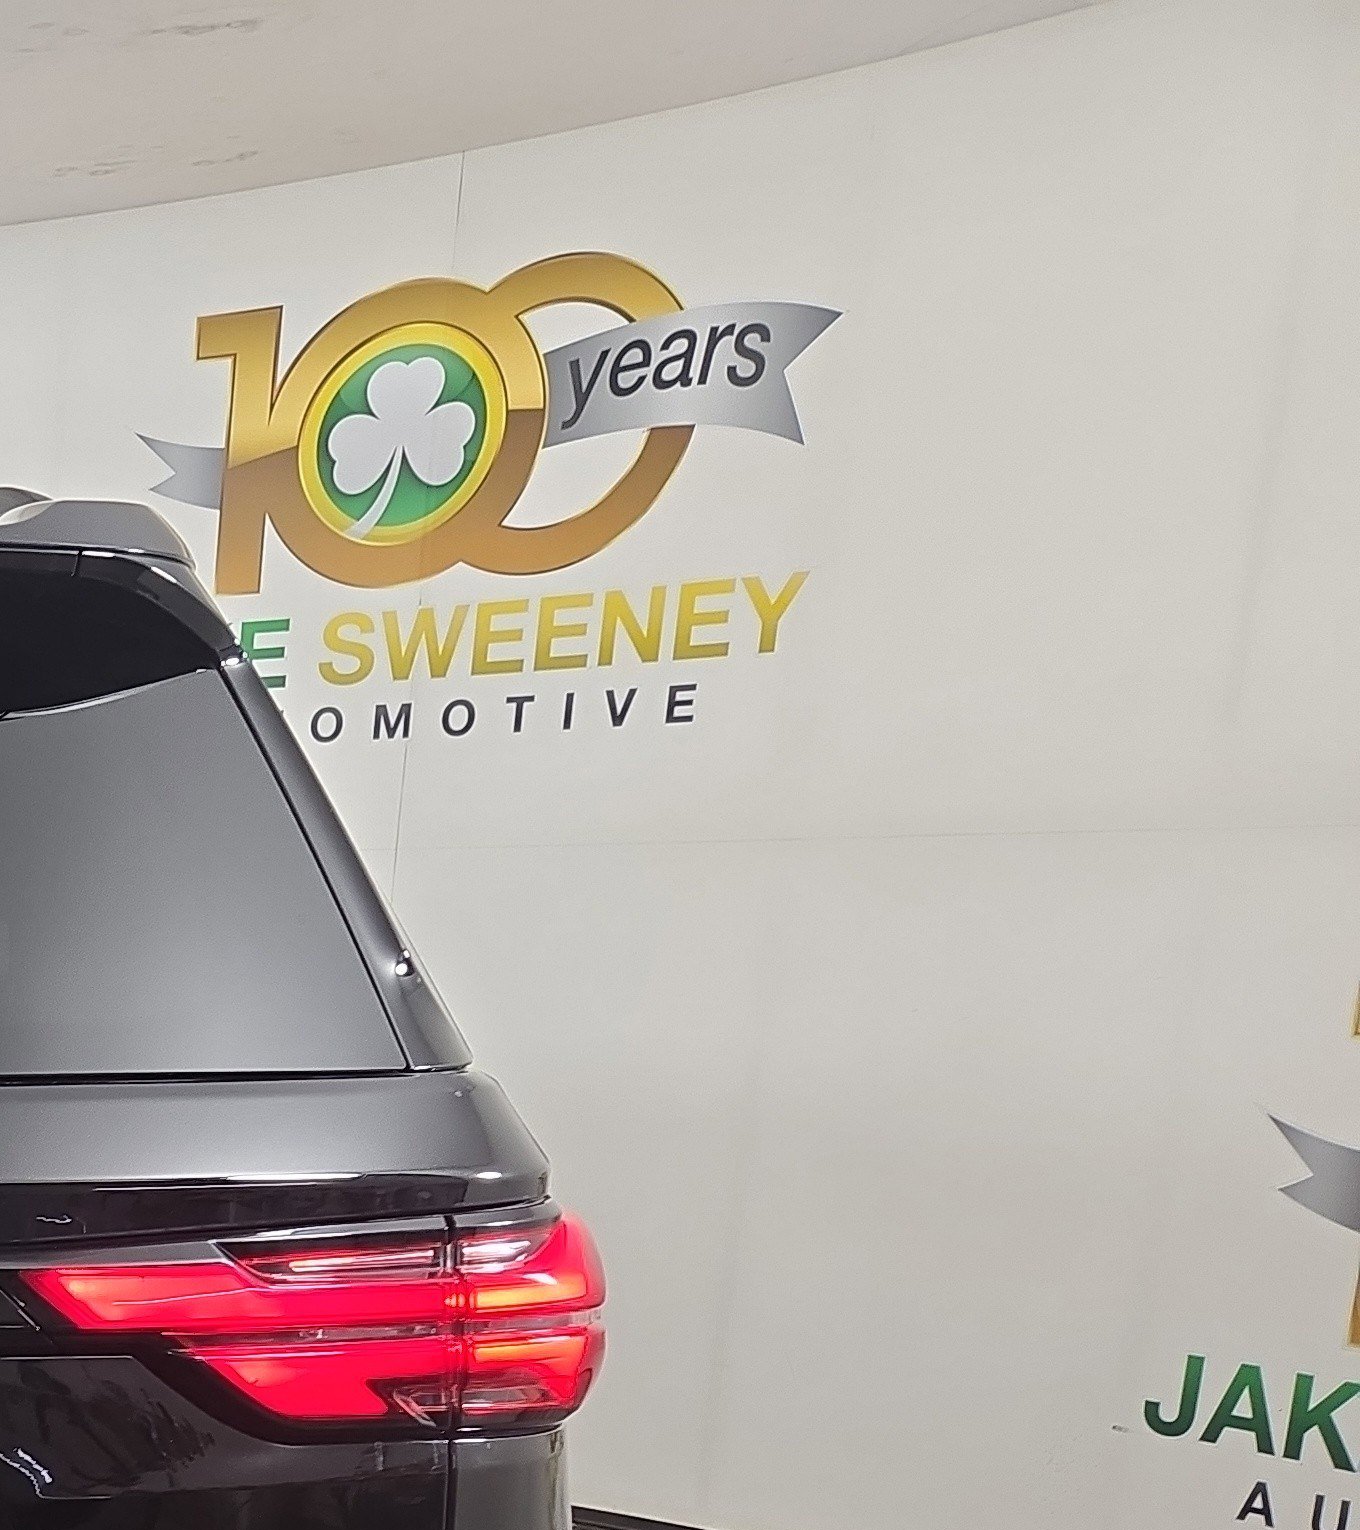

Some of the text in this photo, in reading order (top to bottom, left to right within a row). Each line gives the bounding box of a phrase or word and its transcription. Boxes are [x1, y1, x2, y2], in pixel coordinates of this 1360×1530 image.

[560, 321, 772, 430] years
[318, 571, 811, 687] SWEENEY
[278, 682, 698, 742] OMOTIVE
